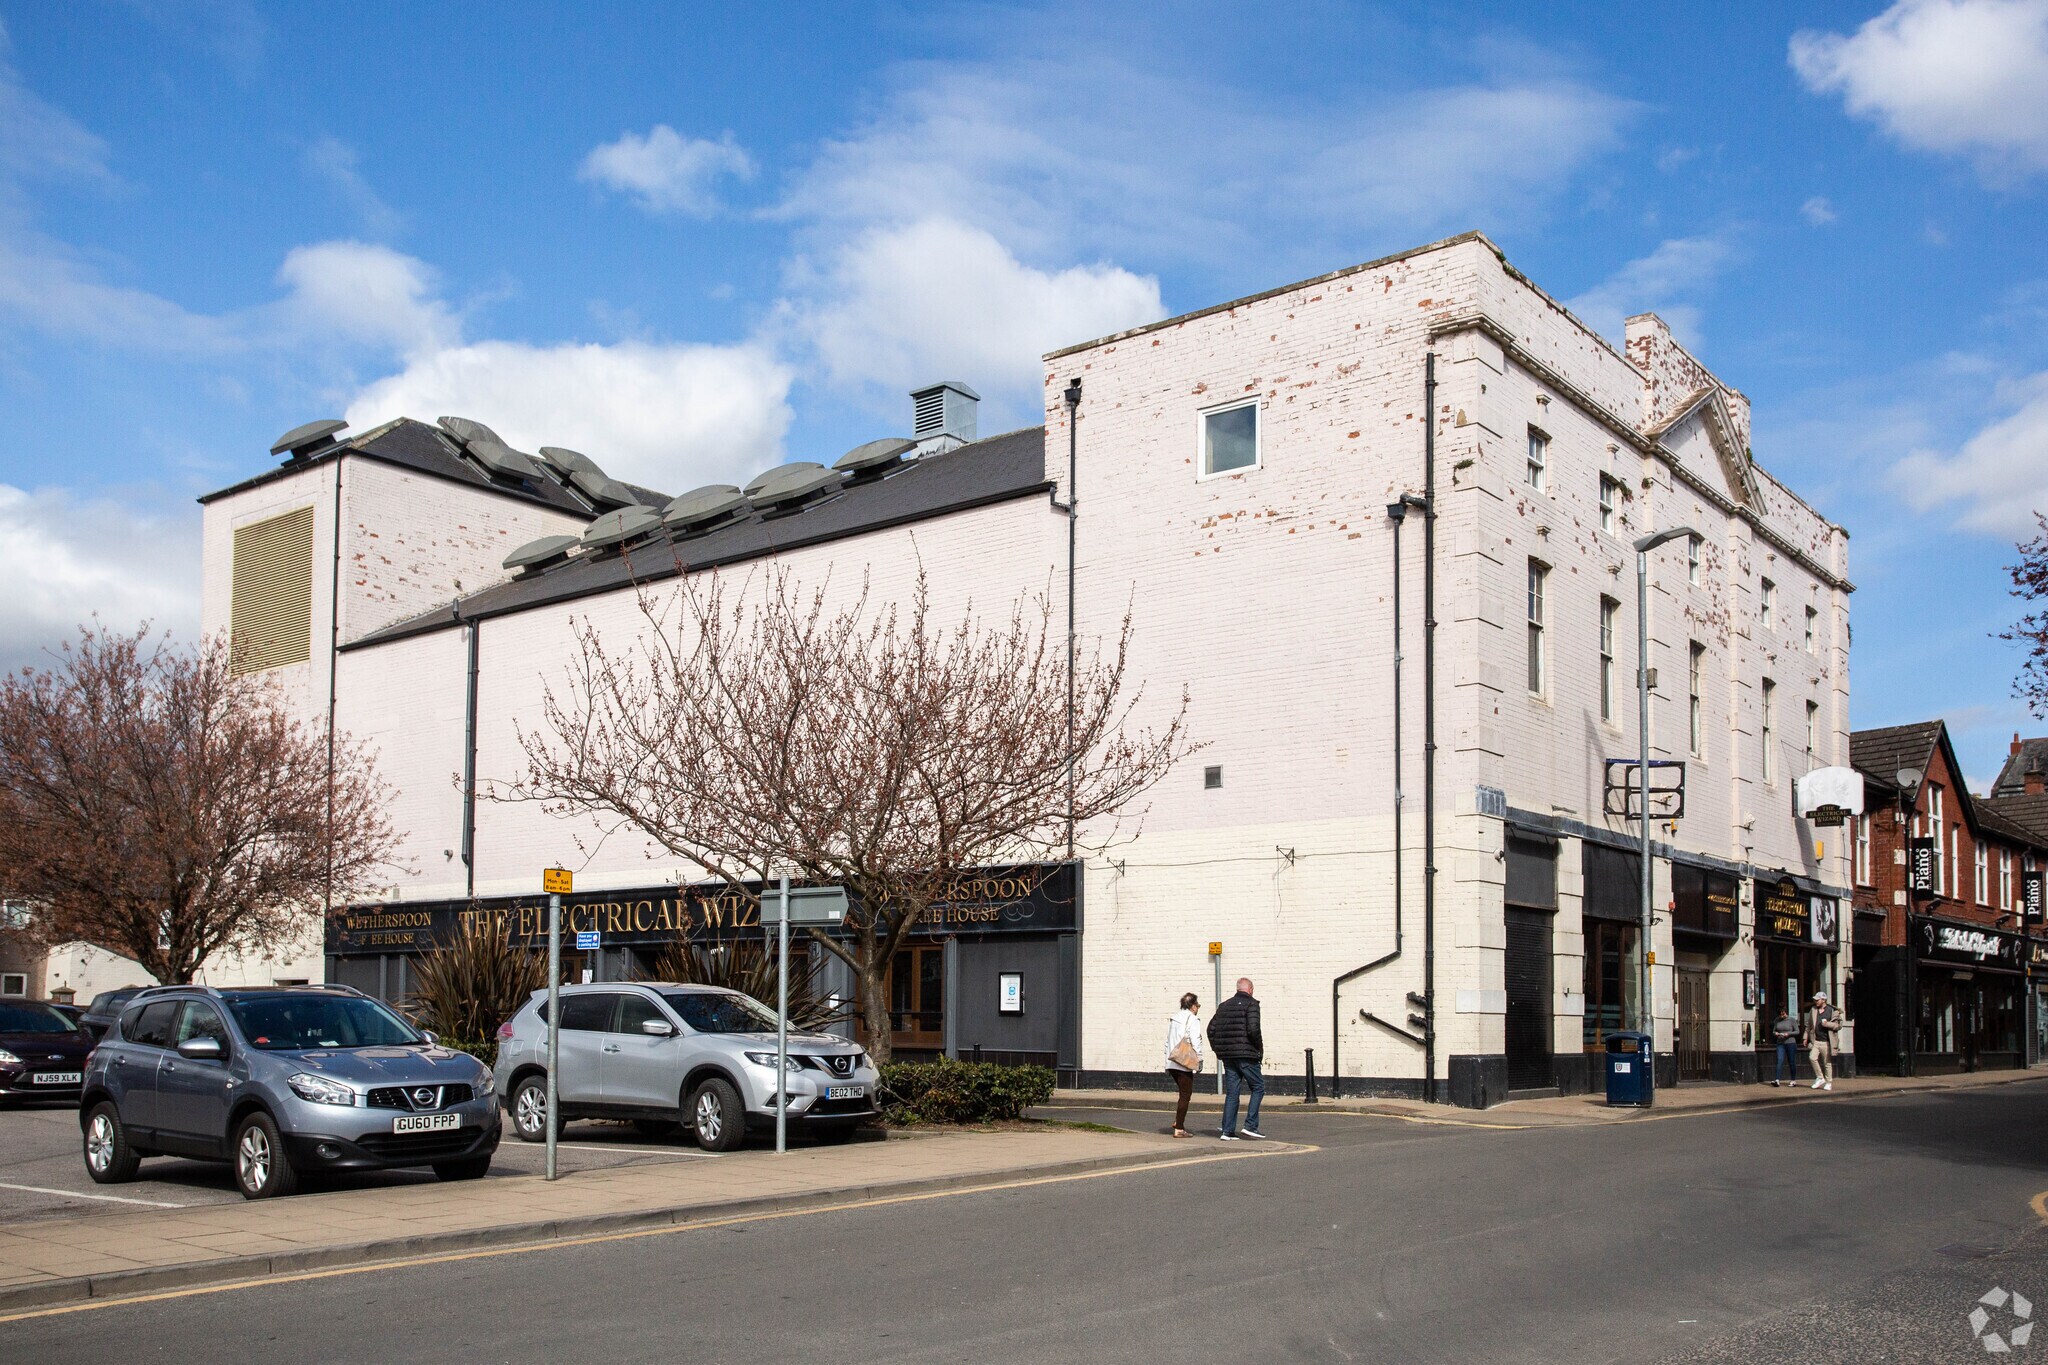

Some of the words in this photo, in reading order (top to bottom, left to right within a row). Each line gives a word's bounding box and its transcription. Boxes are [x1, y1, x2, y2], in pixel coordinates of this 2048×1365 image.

[1916, 848, 1929, 890] Piano
[2028, 880, 2039, 916] Piano
[346, 912, 432, 930] WETHERSPOON
[947, 905, 999, 922] HOUSE
[385, 932, 414, 944] HOUSE
[37, 1074, 60, 1082] NJ59
[61, 1074, 77, 1082] XLK
[830, 1088, 848, 1097] BE02
[399, 1117, 430, 1130] GU60
[434, 1115, 455, 1127] FPP
